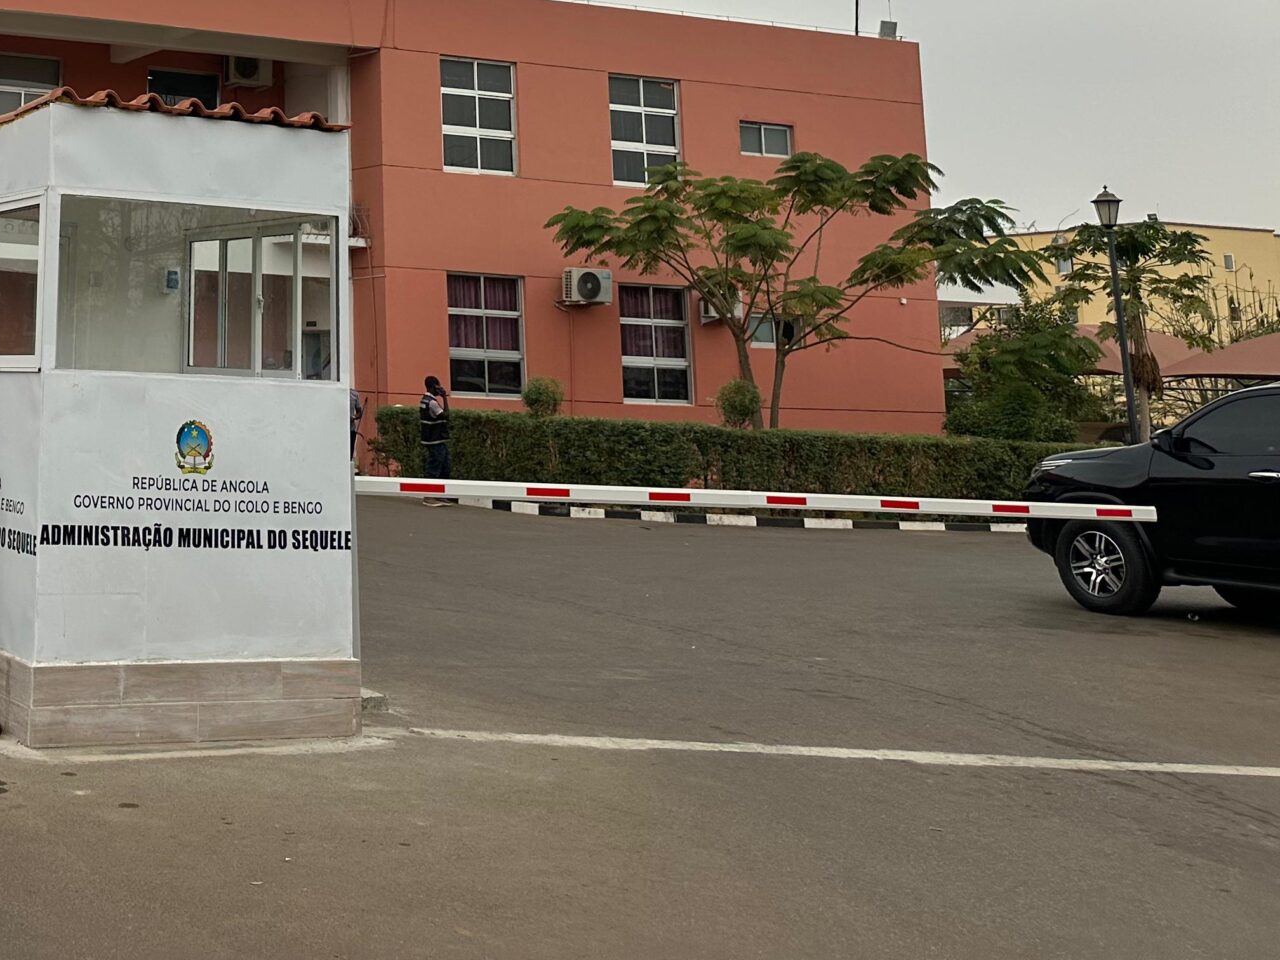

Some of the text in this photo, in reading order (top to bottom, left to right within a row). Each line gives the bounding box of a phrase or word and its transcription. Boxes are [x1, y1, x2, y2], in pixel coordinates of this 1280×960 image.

[132, 474, 270, 494] REPÚBLICA DE ANGOLA
[1, 497, 5, 511] E
[5, 498, 25, 516] BENGO
[73, 494, 323, 515] GOVERNO PROVINCIAL DO ICOLO E BENGO
[7, 528, 37, 556] SEQUELE
[39, 523, 352, 552] ADMINISTRAÇÃO MUNICIPAL DO SEQUELE
